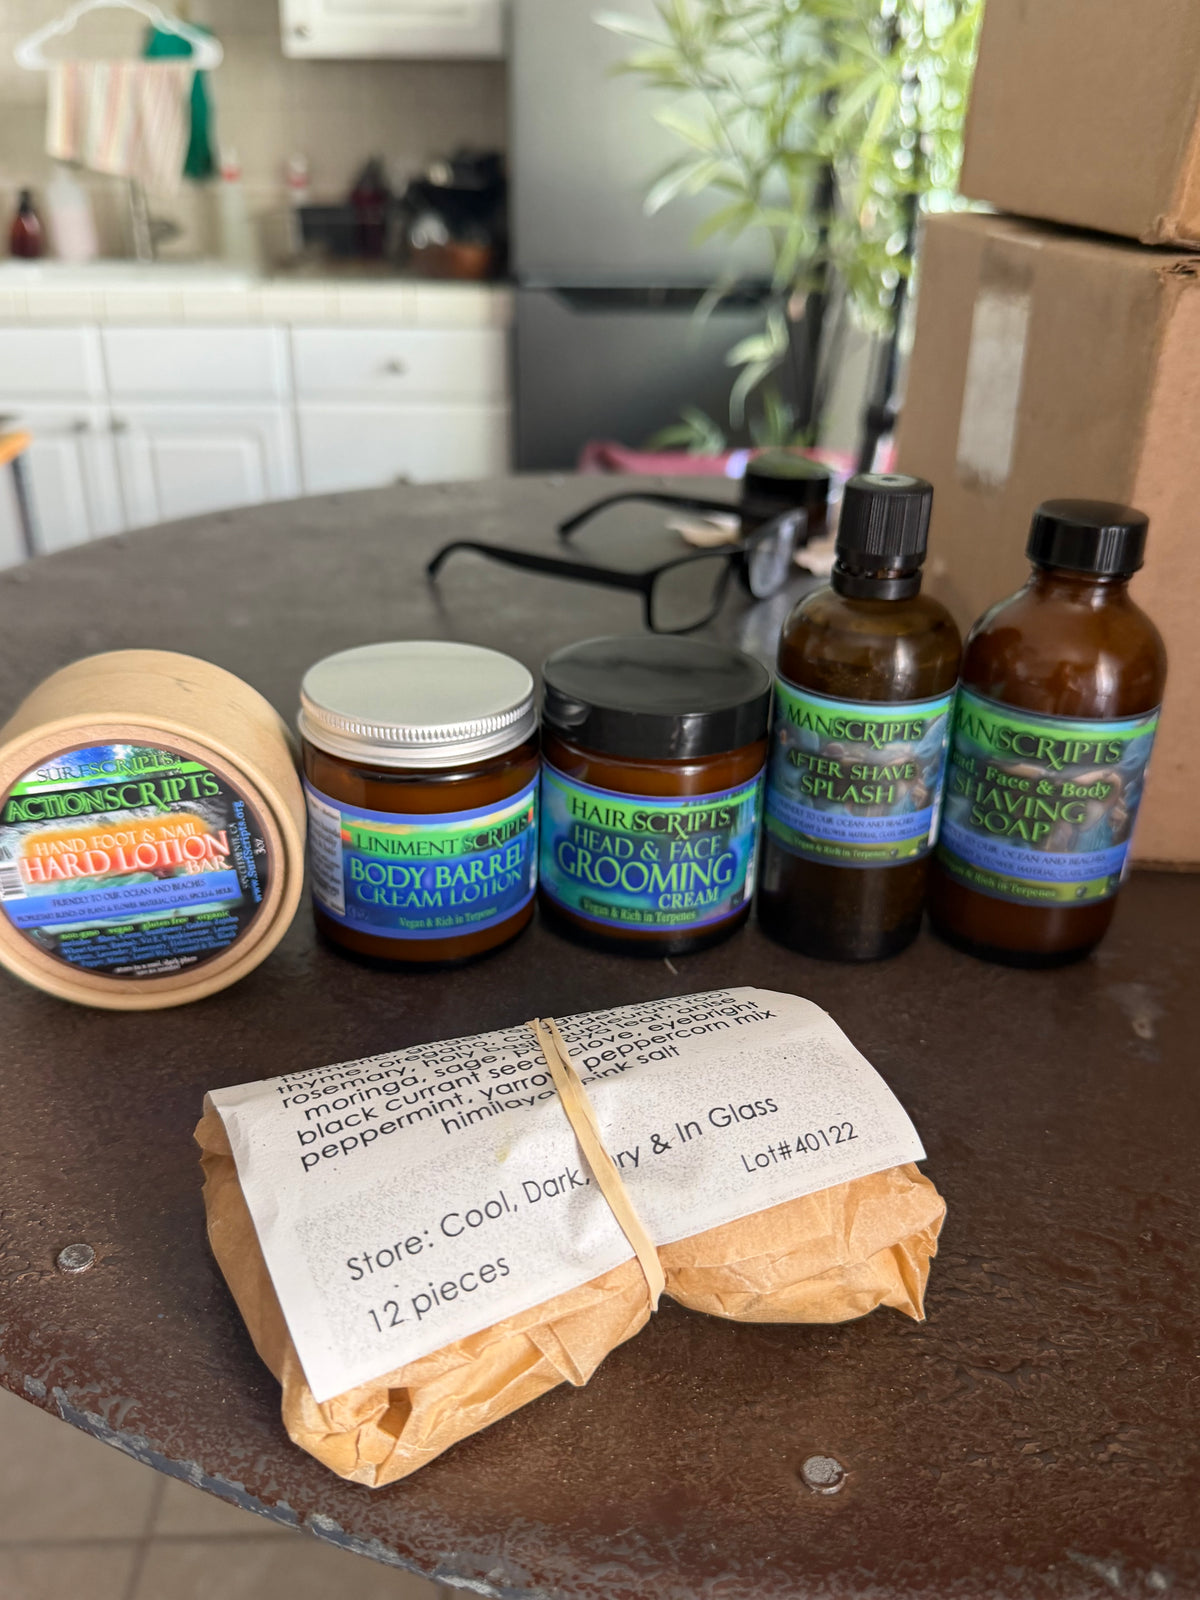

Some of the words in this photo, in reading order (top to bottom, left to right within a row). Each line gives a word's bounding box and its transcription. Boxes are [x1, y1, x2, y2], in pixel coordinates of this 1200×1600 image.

[788, 705, 922, 749] MANSCRIPTS
[788, 749, 843, 779] AFTER
[849, 763, 915, 781] SHAVE
[800, 775, 895, 804] SPLASH
[985, 766, 1031, 792] Face
[1035, 779, 1056, 796] &
[1060, 781, 1111, 800] Body
[4, 772, 219, 823] ACTIONSCRIPTS
[572, 796, 627, 830] HAIR
[632, 806, 731, 841] SCRIPTS
[954, 772, 1088, 824] SHAVING
[969, 804, 1051, 842] SOAP
[21, 849, 111, 883] HARD
[118, 829, 230, 871] LOTION
[91, 830, 138, 849] FOOT
[142, 828, 156, 842] &
[160, 822, 201, 839] NAIL
[232, 800, 262, 903] www.SurfScripts.org
[356, 832, 459, 857] LINIMENT
[463, 812, 530, 850] SCRIPTS
[574, 824, 634, 859] HEAD
[639, 841, 660, 862] &
[668, 834, 722, 862] FACE
[185, 854, 233, 876] BAR
[351, 856, 426, 890] BODY
[435, 842, 525, 889] BARREL
[356, 882, 443, 909] CREAM
[450, 867, 522, 906] LOTION
[557, 841, 733, 894] GROOMING
[657, 886, 719, 911] CREAM
[276, 1067, 370, 1094] thyme,
[378, 1041, 496, 1069] oregano,
[282, 1066, 416, 1109] rosemary,
[421, 1049, 475, 1068] holy
[296, 1106, 380, 1147] black
[385, 1070, 481, 1113] currant
[568, 1032, 642, 1058] clove,
[647, 1000, 759, 1032] eyebright
[303, 1074, 427, 1121] moringa,
[433, 1055, 507, 1079] sage,
[512, 1028, 614, 1059] paaya
[676, 997, 737, 1015] anise
[299, 1091, 474, 1173] peppermint,
[581, 1019, 731, 1073] peppercorn
[733, 1009, 777, 1025] mix
[440, 1086, 559, 1135] himilaya
[580, 1060, 635, 1086] pink
[636, 1044, 681, 1065] salt
[740, 1121, 859, 1174] Lot#40122
[346, 1230, 434, 1281] Store:
[439, 1190, 519, 1238] Cool,
[521, 1166, 591, 1204] Dark,
[610, 1145, 641, 1169] ry
[649, 1132, 673, 1156] &
[674, 1121, 704, 1143] In
[708, 1097, 779, 1129] Glass
[367, 1299, 406, 1333] 12
[410, 1257, 511, 1321] pieces
